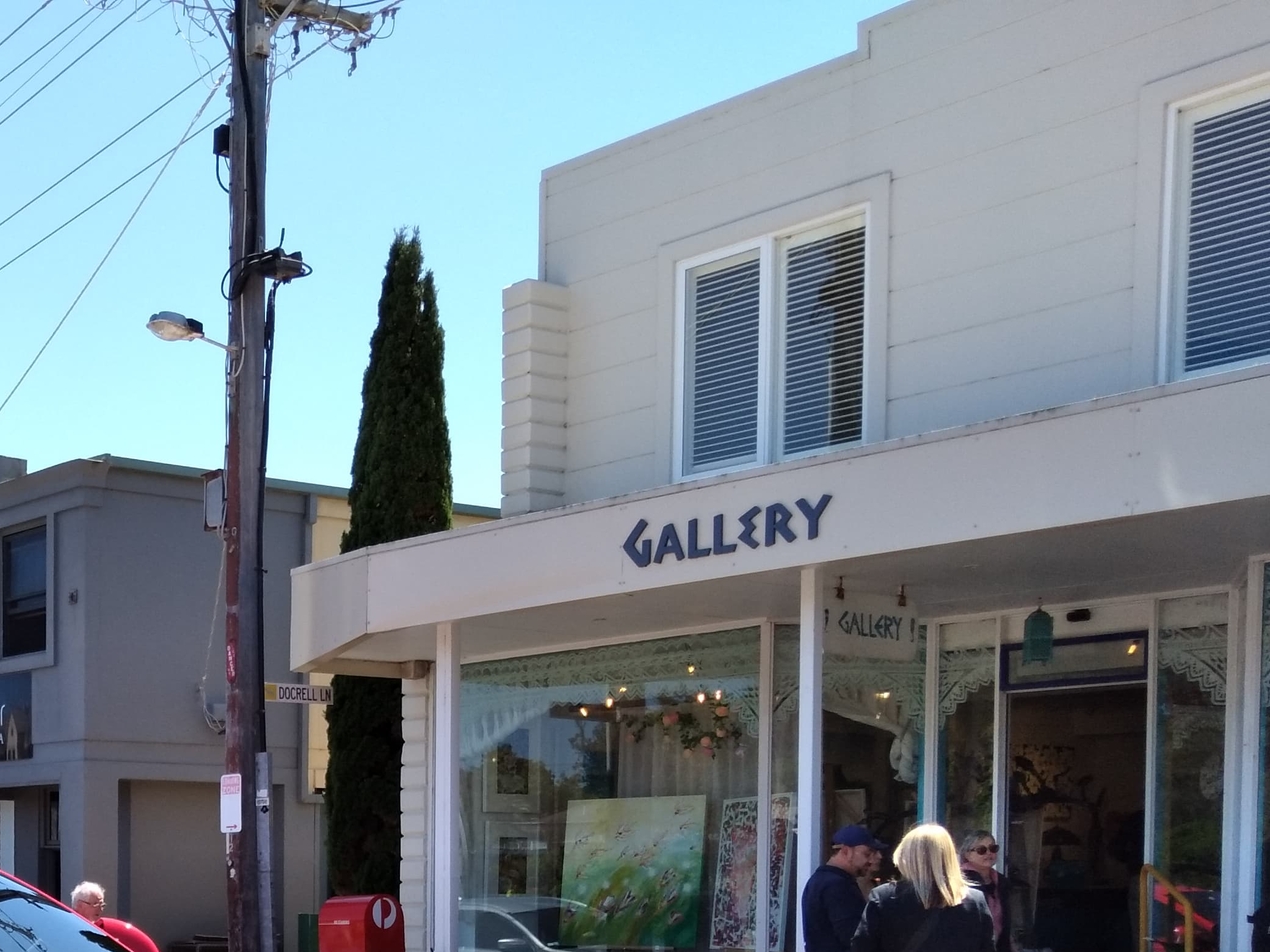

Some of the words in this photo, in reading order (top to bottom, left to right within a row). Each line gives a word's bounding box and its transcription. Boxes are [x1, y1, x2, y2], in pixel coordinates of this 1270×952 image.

[622, 494, 833, 568] GALLERY
[838, 610, 903, 641] GALLERY
[278, 686, 318, 701] DOCRELL
[319, 688, 331, 702] LN
[222, 785, 240, 795] ZONE
